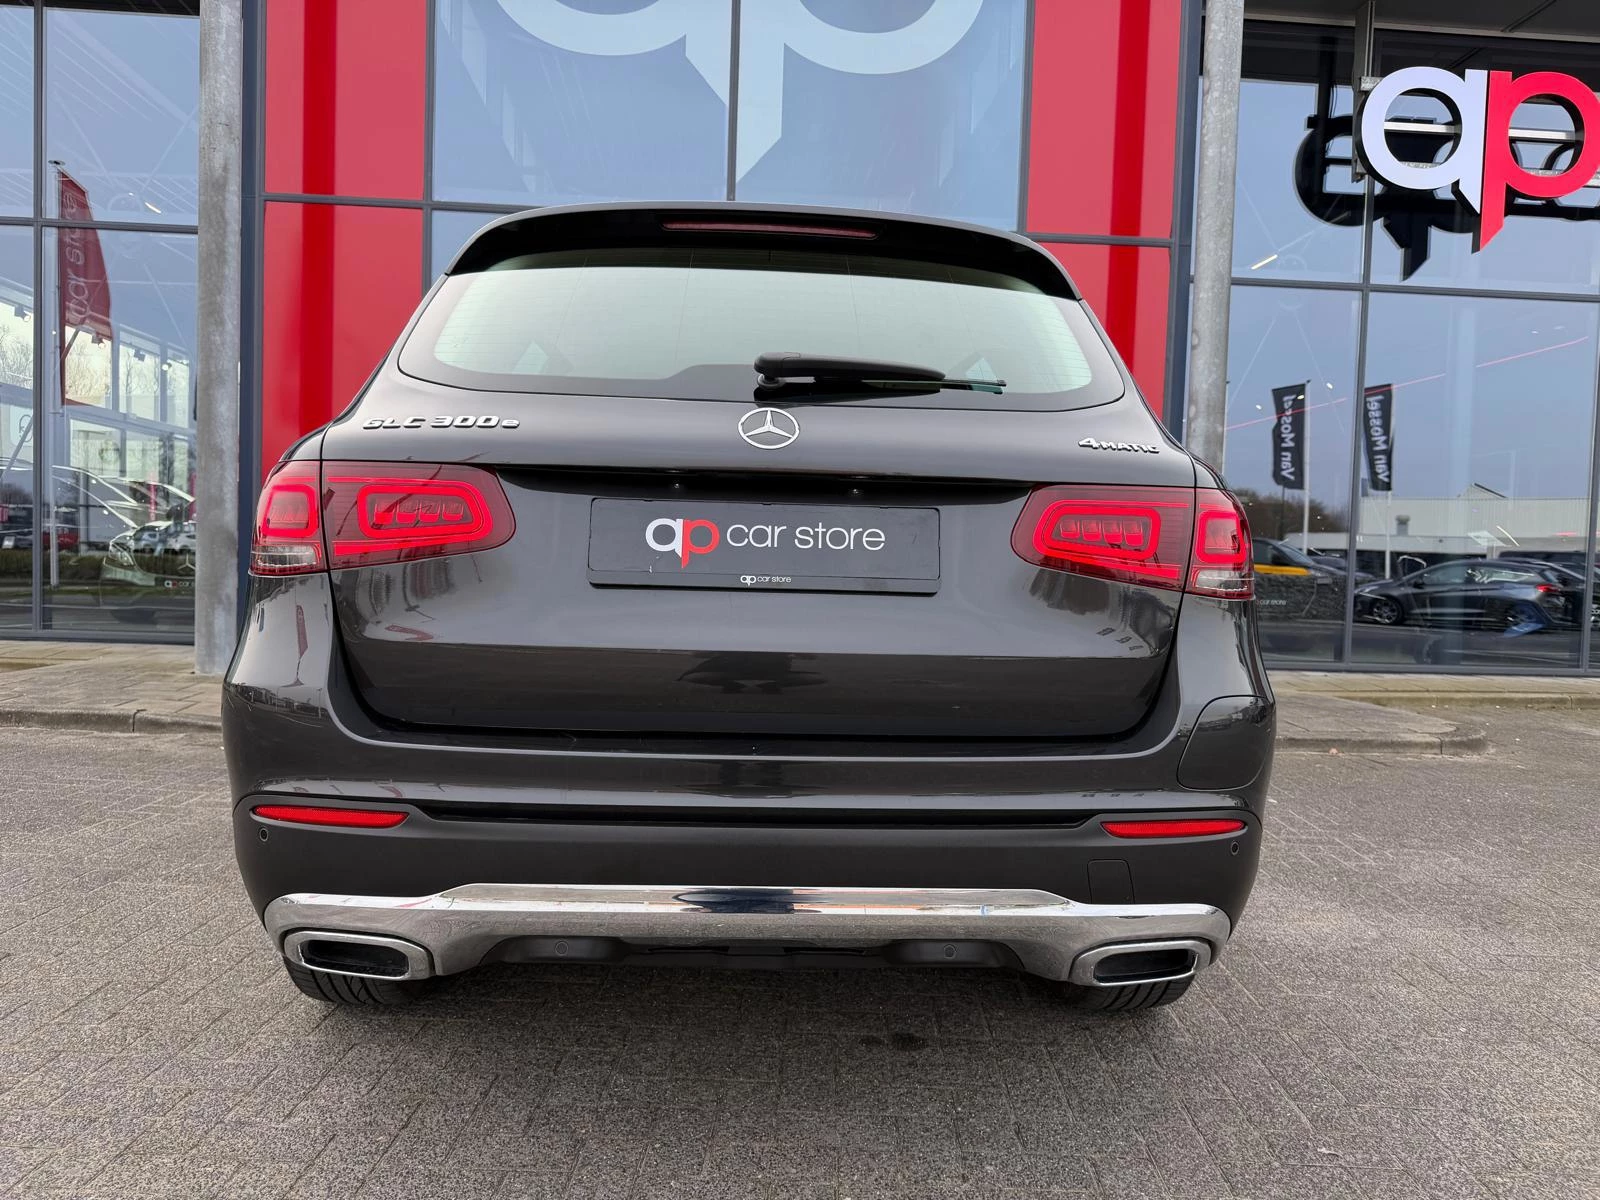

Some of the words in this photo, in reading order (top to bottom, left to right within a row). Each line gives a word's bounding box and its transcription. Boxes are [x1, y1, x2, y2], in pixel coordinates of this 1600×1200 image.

[1361, 66, 1600, 251] ap
[363, 416, 426, 430] GLC
[1078, 437, 1160, 454] 4MATIC
[645, 518, 720, 568] ap
[726, 524, 787, 548] car
[794, 522, 886, 551] store
[771, 575, 792, 583] store
